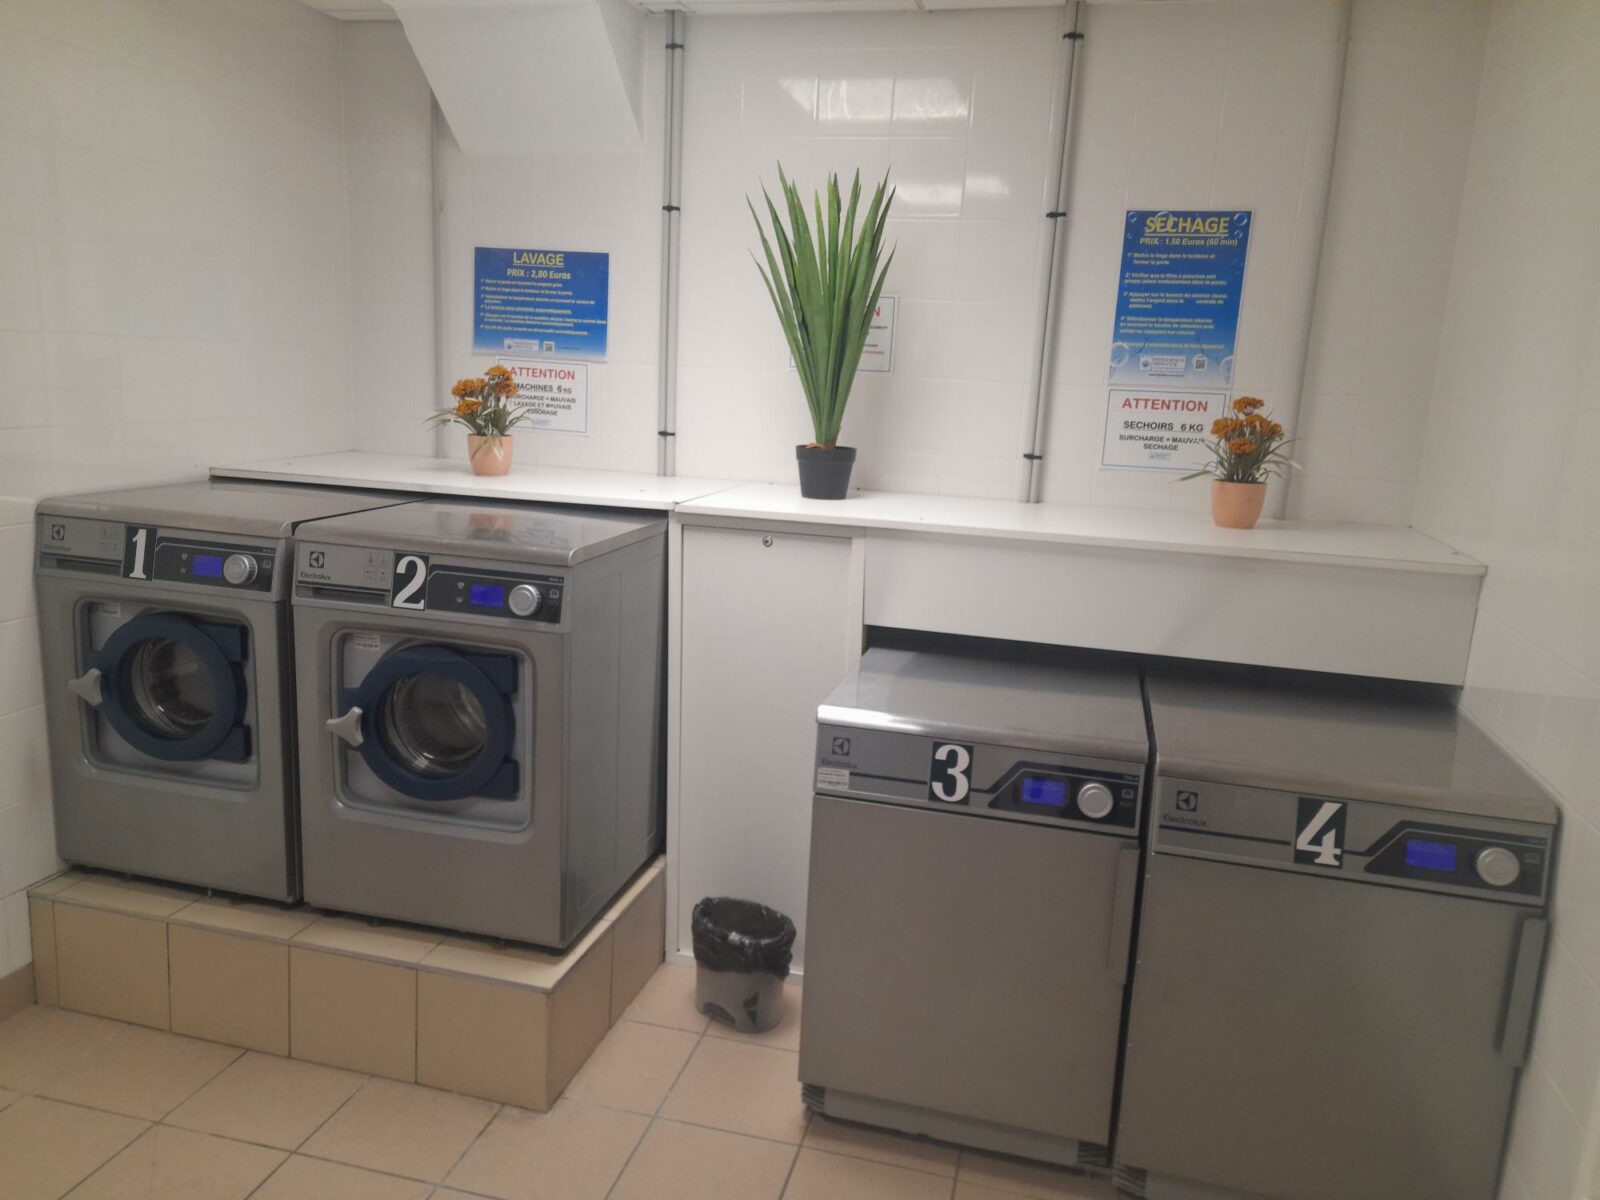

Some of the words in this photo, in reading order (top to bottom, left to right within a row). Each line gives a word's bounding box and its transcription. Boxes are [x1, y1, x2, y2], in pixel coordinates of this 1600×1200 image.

[1144, 217, 1230, 233] SECHAGE
[1182, 238, 1205, 246] Euros
[1206, 238, 1219, 247] (60
[1220, 239, 1238, 247] min)
[513, 251, 564, 266] LAVAGE
[506, 268, 525, 277] PRIX
[531, 270, 548, 279] 2,80
[549, 271, 571, 280] Euros
[511, 366, 575, 380] ATTENTION
[557, 385, 562, 393] 6
[1122, 398, 1208, 412] ATTENTION
[1123, 421, 1174, 431] SECHOIRS
[1181, 423, 1187, 431] 6
[1189, 424, 1204, 432] KG
[1119, 434, 1165, 442] SURCHARGE
[129, 529, 148, 579] 1
[300, 572, 332, 581] Electrolux
[392, 556, 427, 610] 2
[932, 744, 970, 802] 3
[1162, 814, 1207, 826] Electrolux
[1296, 802, 1343, 866] 4
